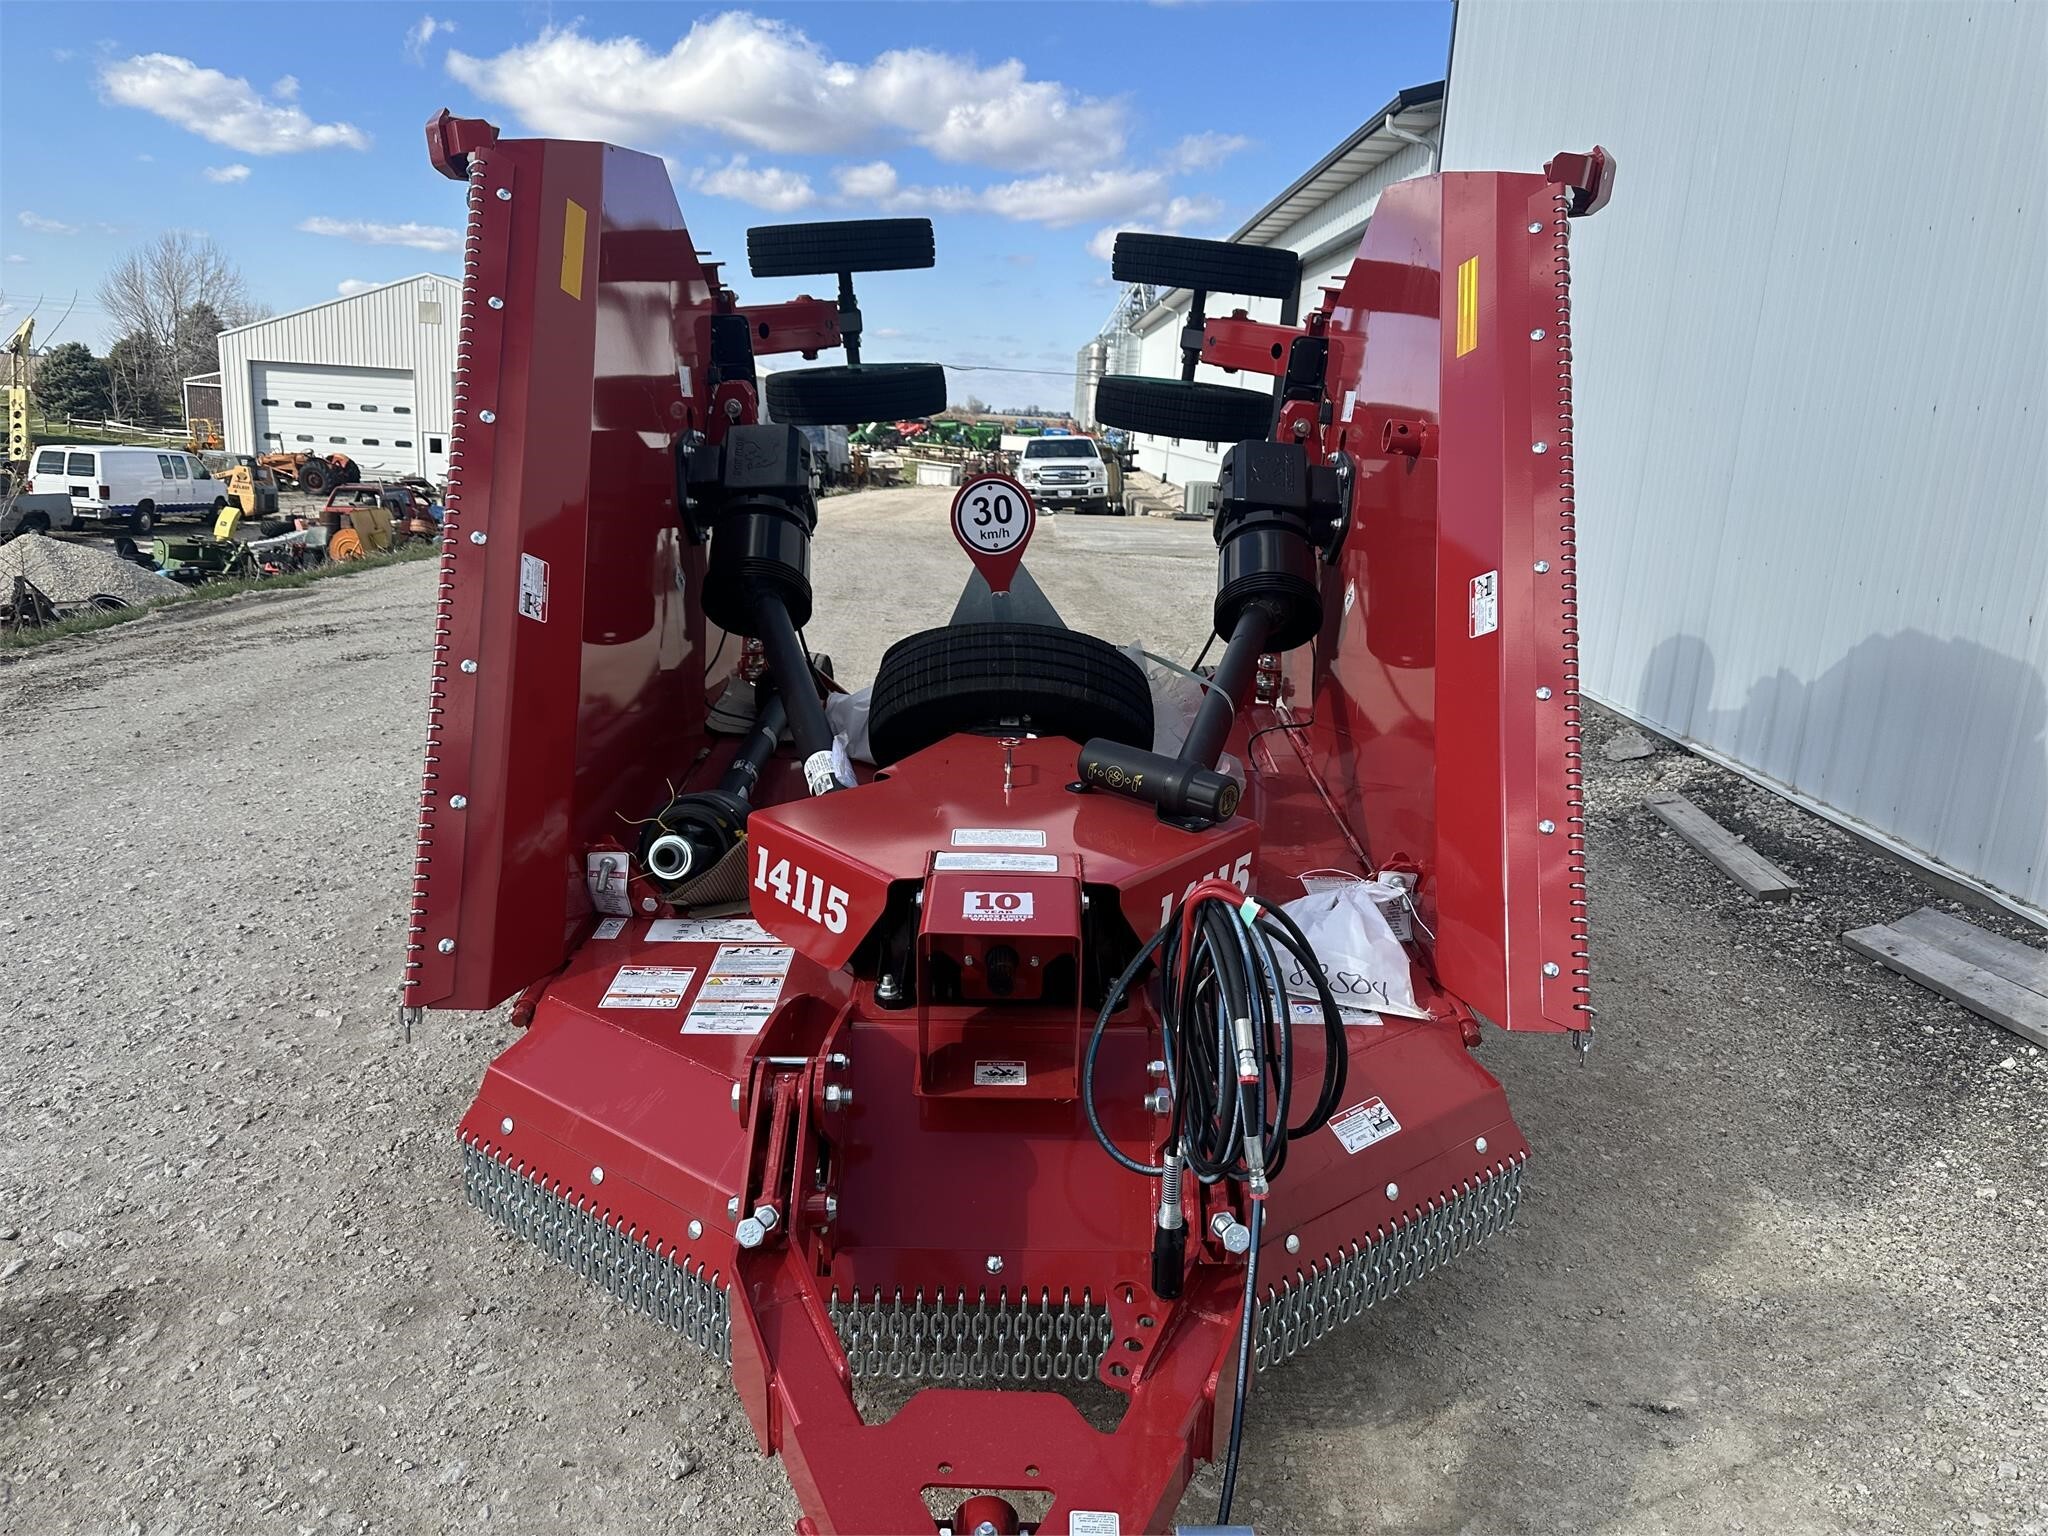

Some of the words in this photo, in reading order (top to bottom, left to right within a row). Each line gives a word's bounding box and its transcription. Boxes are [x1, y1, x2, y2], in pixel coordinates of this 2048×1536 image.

[972, 494, 1012, 526] 30
[980, 528, 1010, 540] km/h
[754, 845, 849, 934] 14115
[975, 894, 1021, 910] 10
